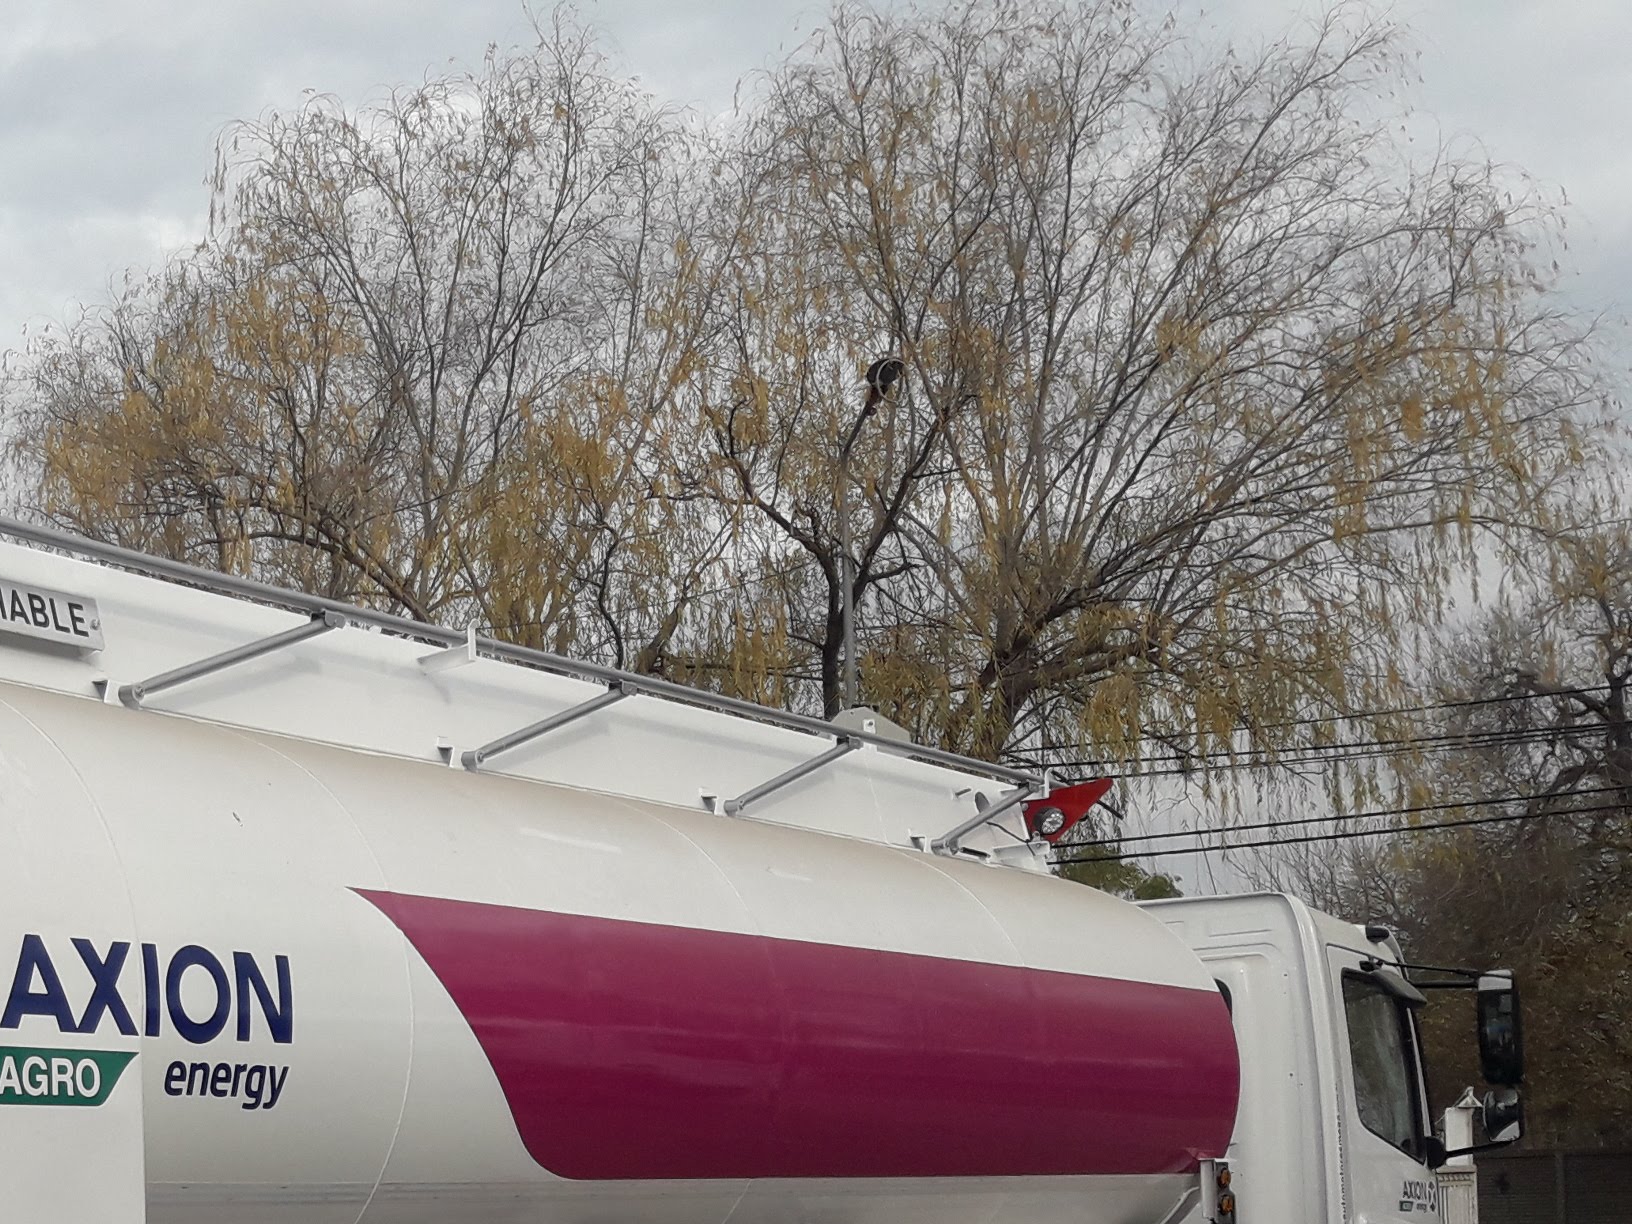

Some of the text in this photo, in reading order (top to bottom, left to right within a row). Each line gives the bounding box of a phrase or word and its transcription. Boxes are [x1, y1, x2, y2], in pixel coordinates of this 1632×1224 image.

[0, 934, 293, 1044] AXION
[164, 1060, 289, 1110] energy
[1402, 1181, 1428, 1200] AXION
